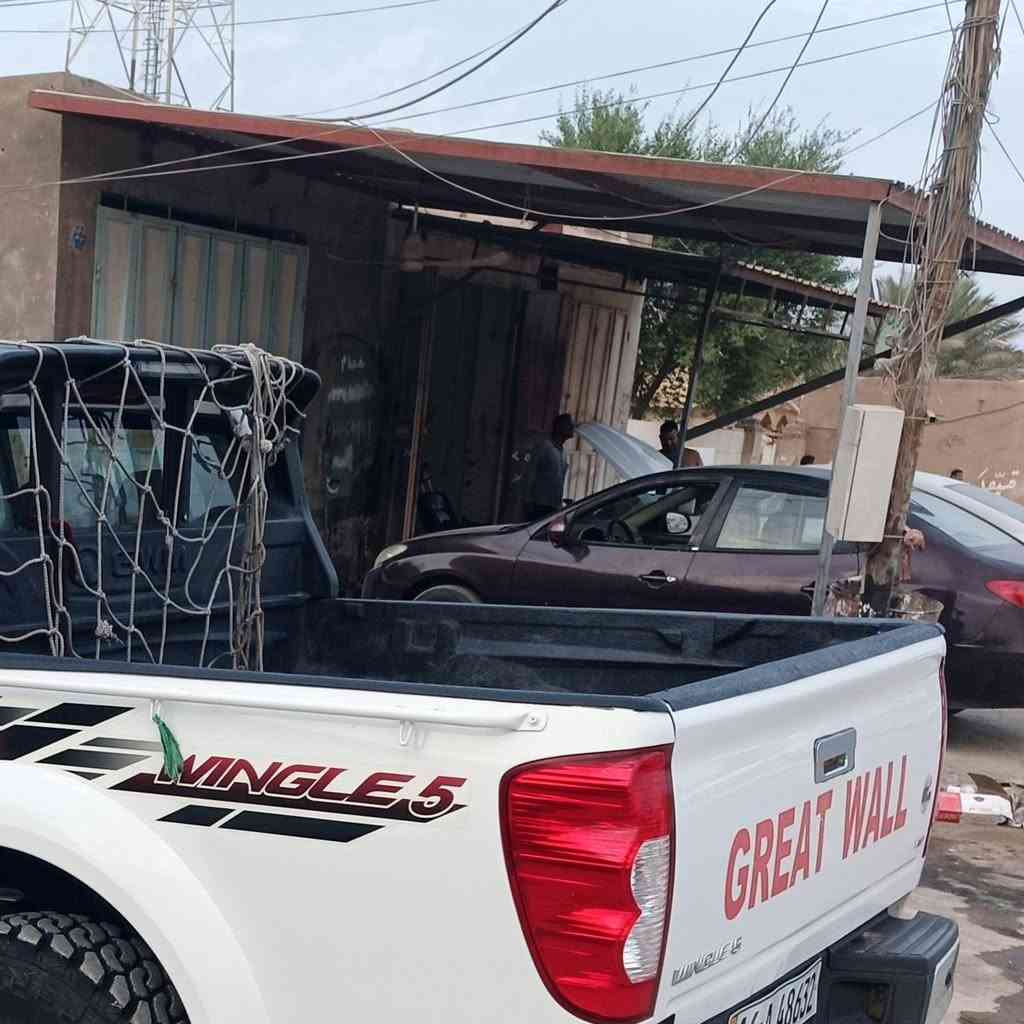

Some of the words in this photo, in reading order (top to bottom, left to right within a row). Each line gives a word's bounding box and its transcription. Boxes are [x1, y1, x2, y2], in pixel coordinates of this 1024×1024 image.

[154, 753, 416, 808] WINGLE
[409, 775, 470, 818] 5
[723, 790, 834, 921] GREAT
[841, 754, 908, 860] WALL
